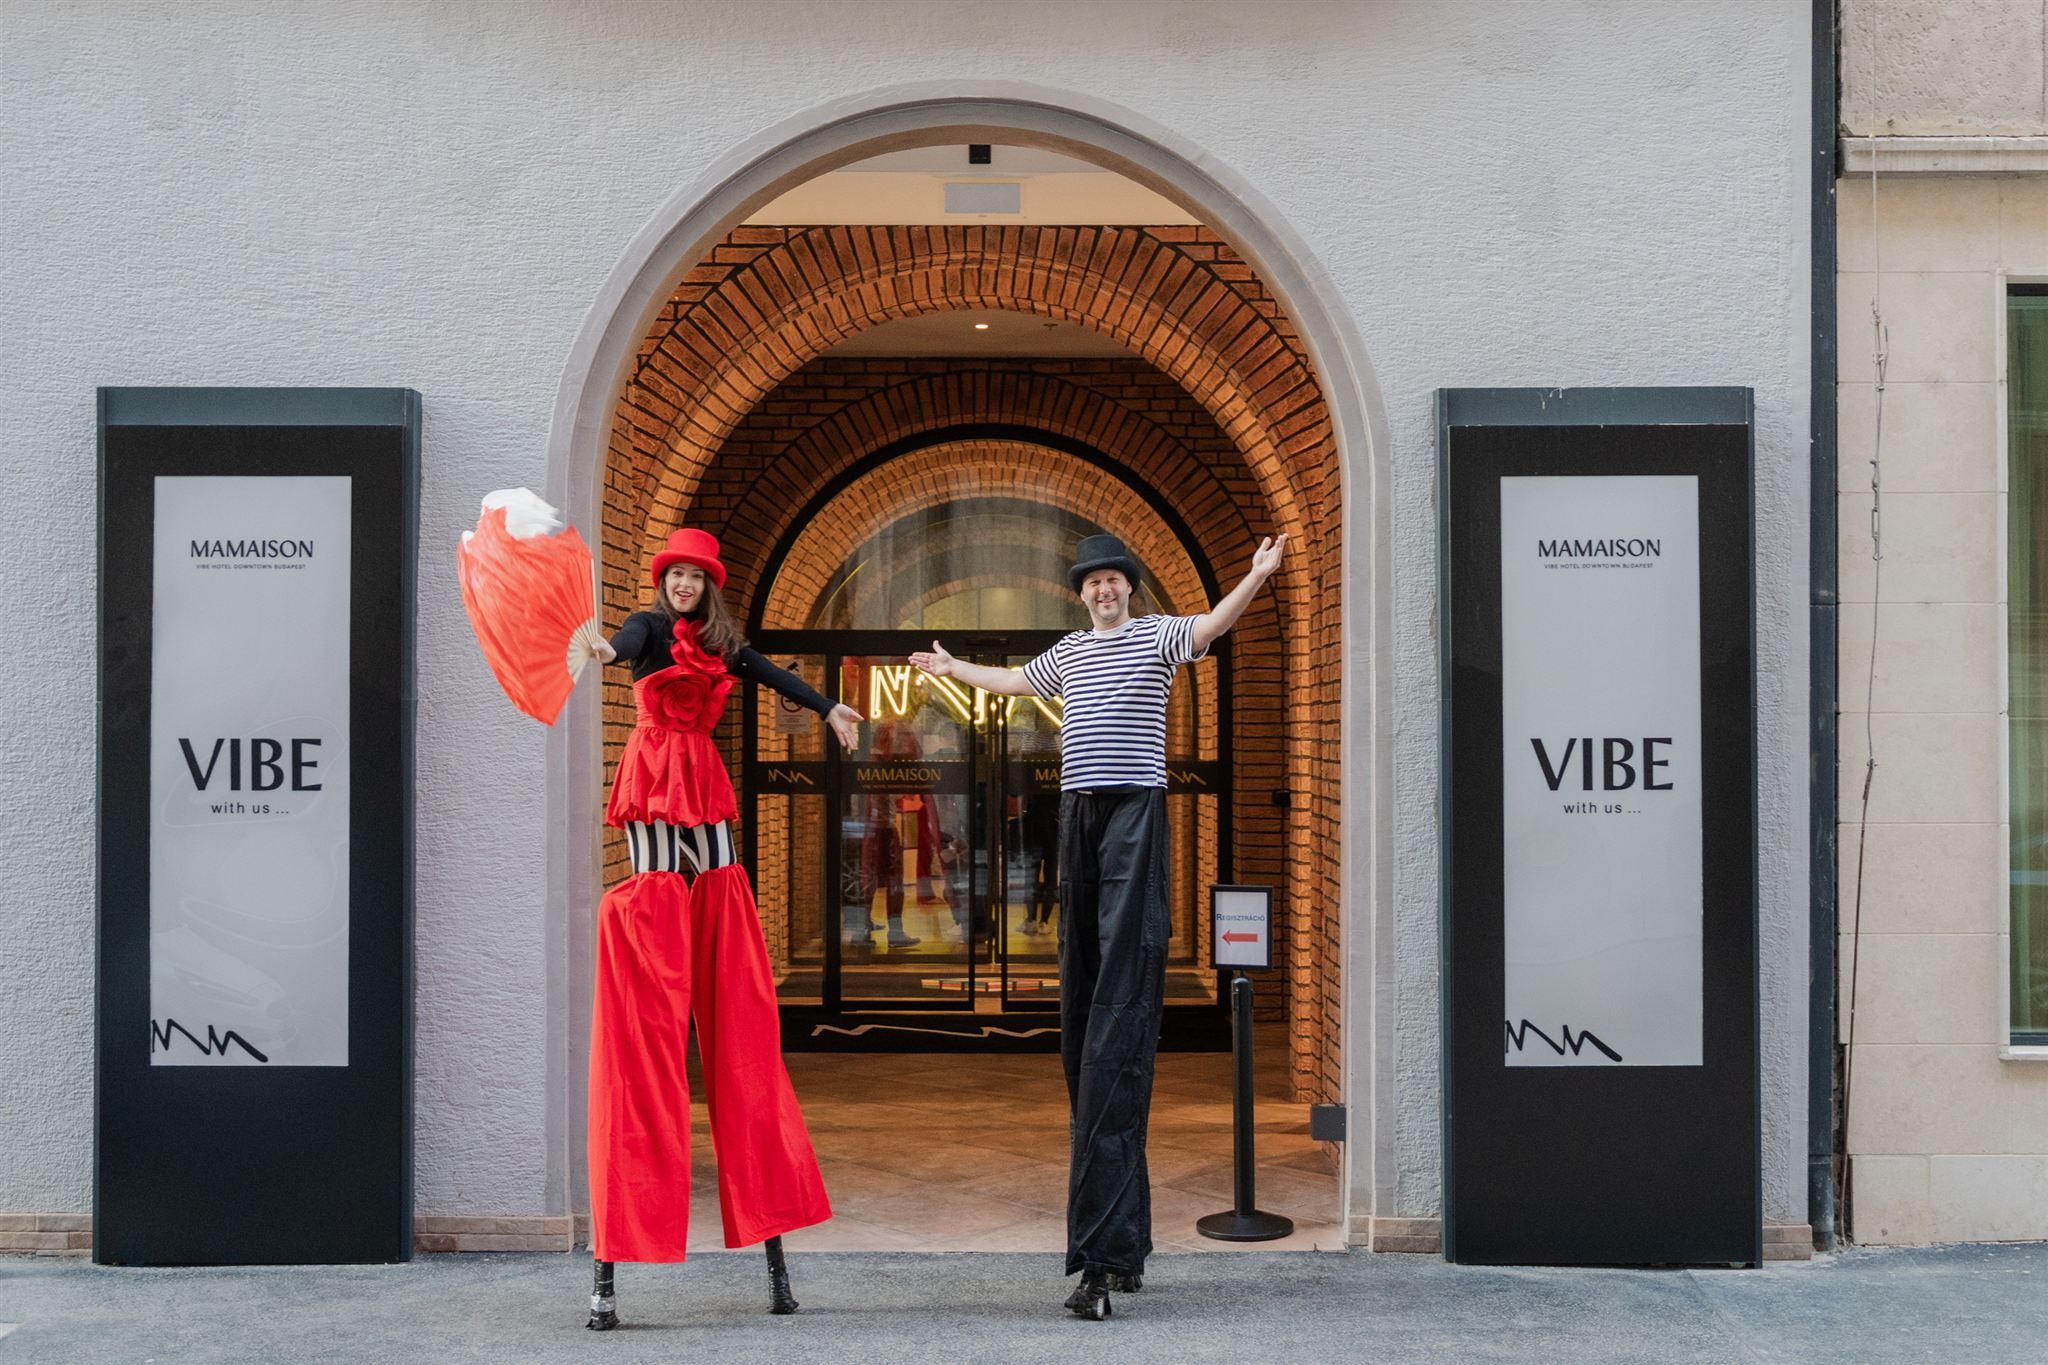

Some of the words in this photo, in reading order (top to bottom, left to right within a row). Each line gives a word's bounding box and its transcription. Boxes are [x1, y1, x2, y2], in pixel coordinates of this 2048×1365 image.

[190, 539, 314, 558] MAMAISON
[1537, 538, 1661, 557] MAMAISON
[178, 738, 322, 791] VIBE
[1530, 737, 1674, 791] VIBE
[857, 767, 942, 782] MAMAISON
[211, 802, 245, 814] with
[1563, 802, 1597, 814] with
